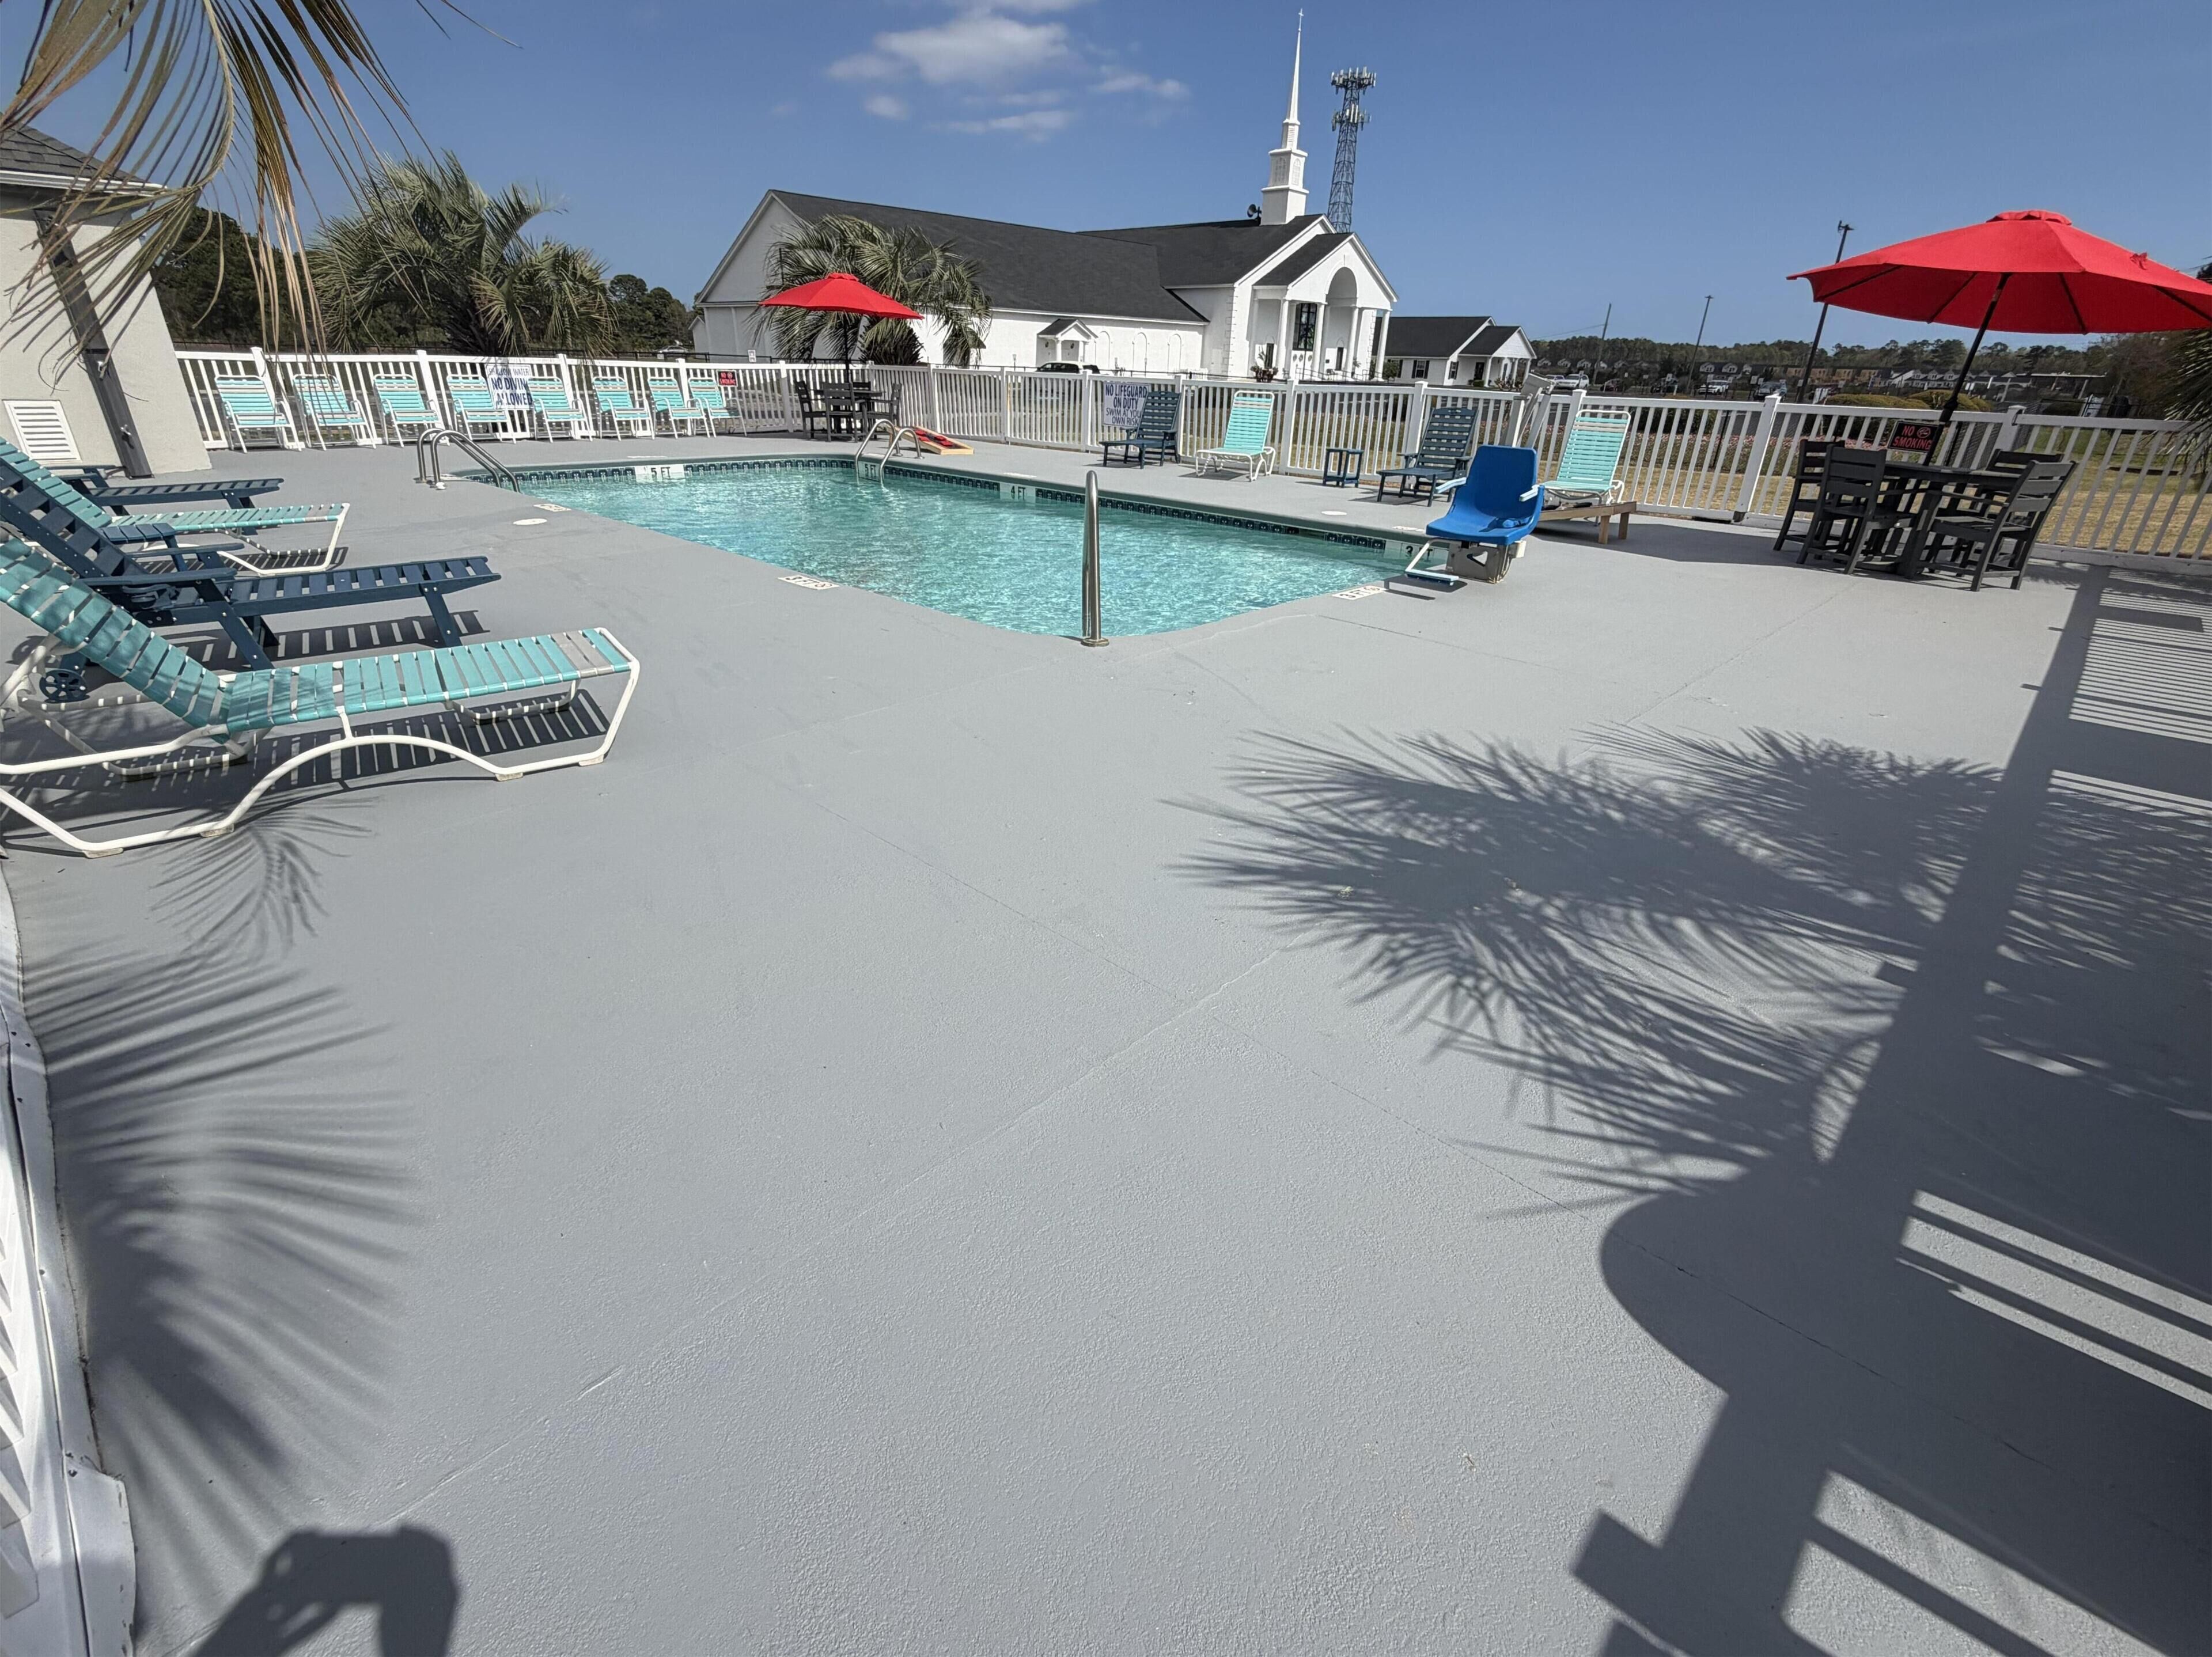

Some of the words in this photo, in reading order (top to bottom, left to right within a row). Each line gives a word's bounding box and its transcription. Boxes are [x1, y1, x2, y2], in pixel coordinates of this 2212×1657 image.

[513, 369, 529, 377] WATER
[491, 377, 503, 390] NO
[504, 377, 527, 390] DIVIN
[1105, 384, 1113, 396] NO
[1115, 385, 1147, 398] LIFEGUARD
[1113, 397, 1122, 408] ON
[1123, 397, 1138, 409] DUTY
[1106, 407, 1121, 417] SWIM
[1130, 409, 1141, 418] YOU
[1112, 416, 1125, 425] OWN
[1127, 418, 1139, 426] RISK
[1902, 426, 1915, 436] NO
[1893, 436, 1933, 449] SMOKING
[650, 468, 657, 479] 5
[661, 467, 671, 479] FT
[1018, 486, 1026, 498] FT
